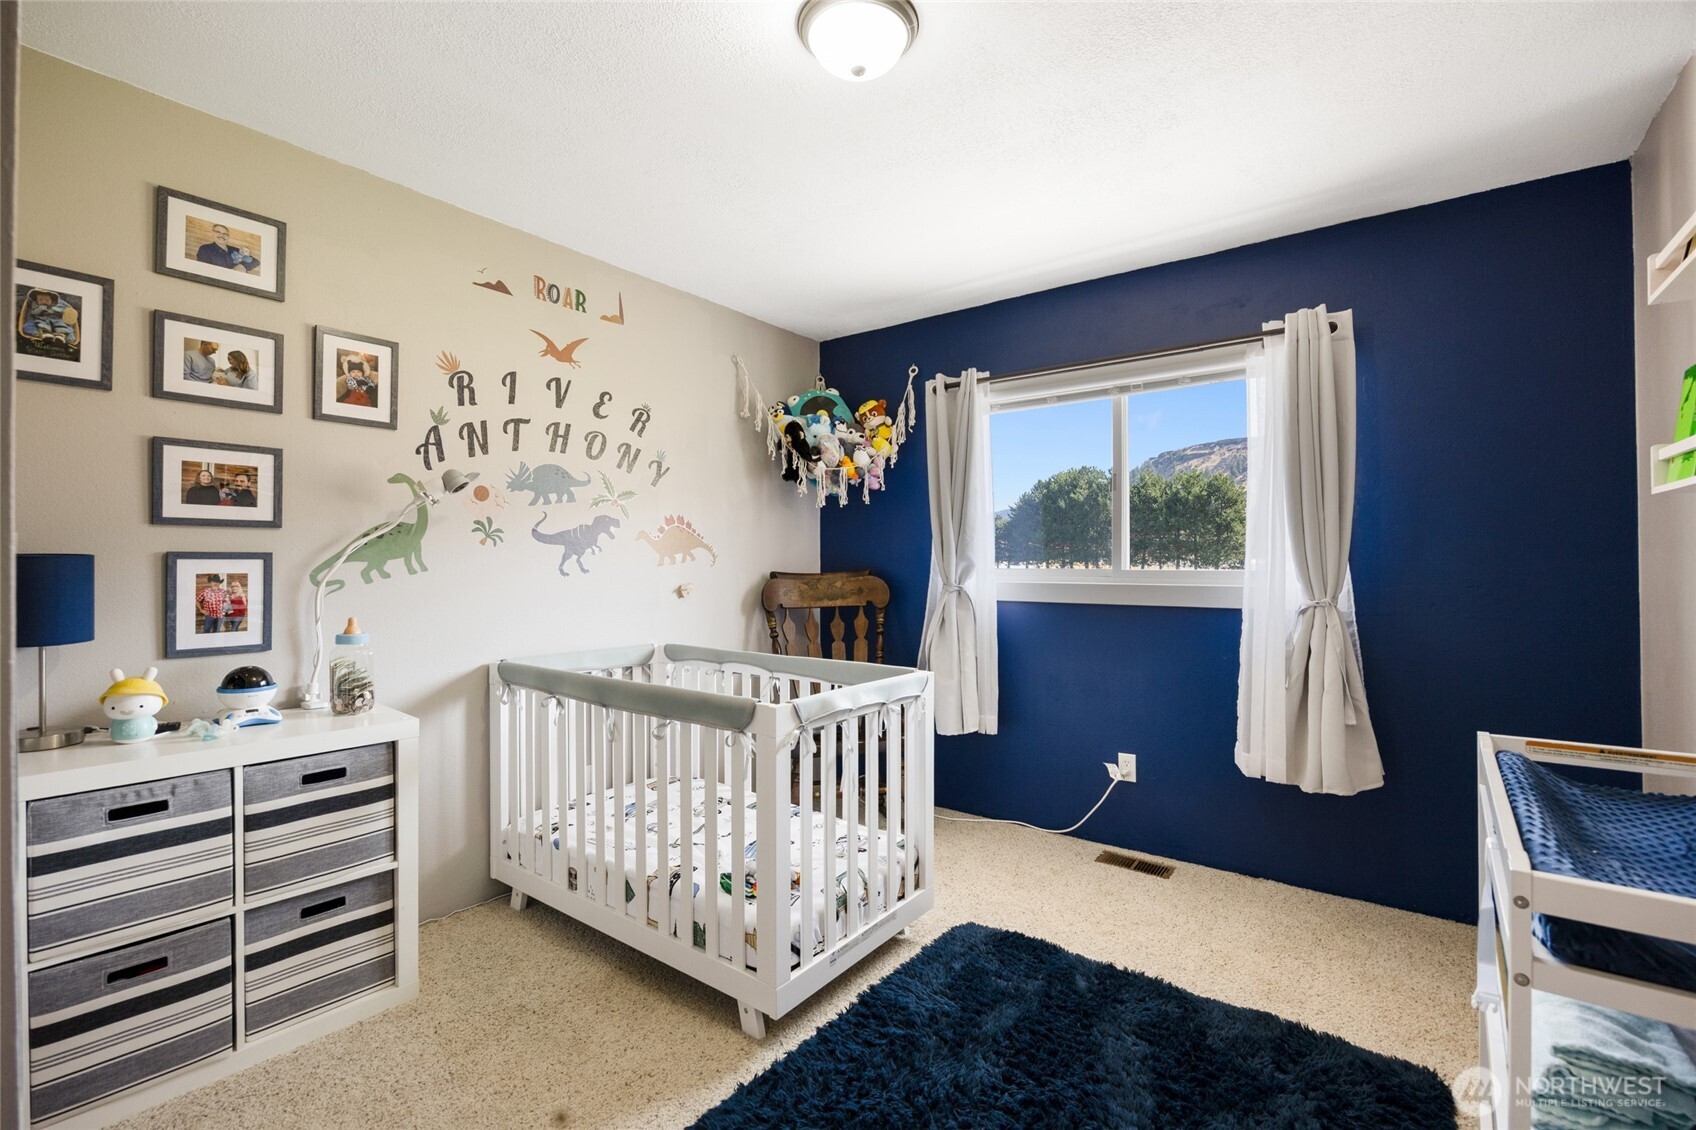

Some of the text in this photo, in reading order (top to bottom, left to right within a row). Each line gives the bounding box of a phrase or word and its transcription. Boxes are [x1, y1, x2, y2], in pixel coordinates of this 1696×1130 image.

[533, 275, 587, 313] ROAR
[448, 370, 651, 438] RIVER
[415, 418, 671, 487] ANTHONY
